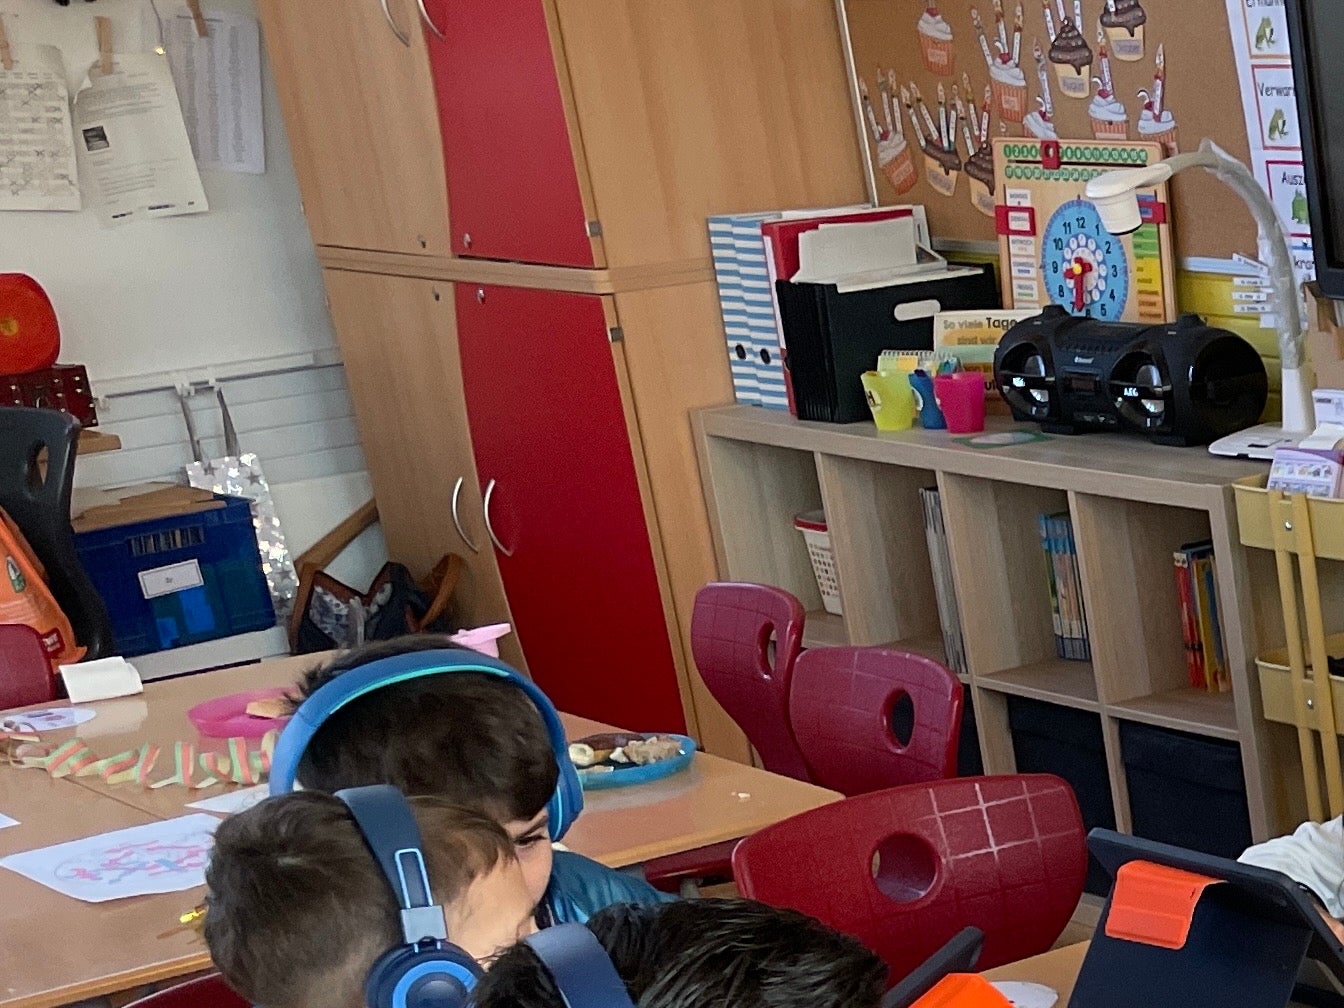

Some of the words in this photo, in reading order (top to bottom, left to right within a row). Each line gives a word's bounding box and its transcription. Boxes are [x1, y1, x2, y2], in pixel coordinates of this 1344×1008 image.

[1258, 81, 1296, 97] Verwar
[1063, 222, 1072, 234] 11
[1076, 217, 1086, 228] 12
[1095, 224, 1099, 236] 1
[1053, 238, 1063, 251] 10
[1105, 241, 1112, 254] 2
[1052, 262, 1058, 274] 9
[1112, 265, 1118, 277] 3
[1058, 285, 1064, 298] 8
[1109, 289, 1115, 300] 4
[1100, 304, 1106, 316] 5
[943, 319, 956, 330] So
[1123, 387, 1139, 397] AEG
